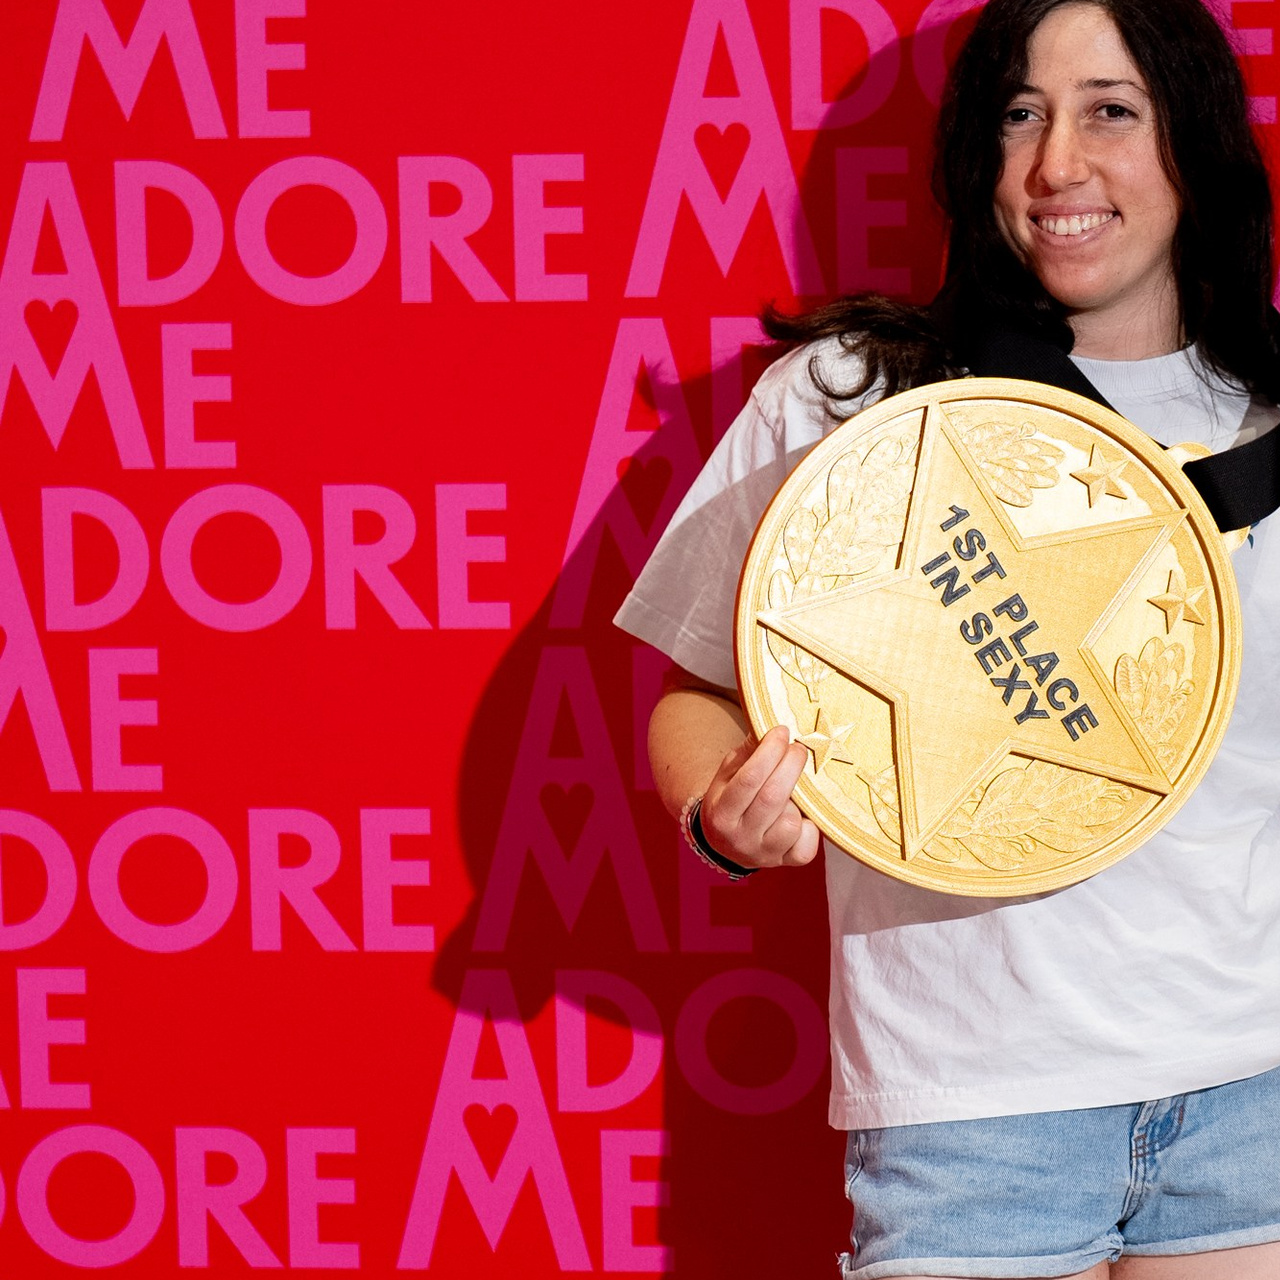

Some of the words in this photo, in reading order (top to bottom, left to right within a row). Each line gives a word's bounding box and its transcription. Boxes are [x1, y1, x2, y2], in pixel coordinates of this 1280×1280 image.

[0, 152, 589, 307] ADORE
[5, 482, 512, 632] DORE
[940, 505, 1007, 584] 1ST
[992, 593, 1099, 742] PLACE
[921, 551, 971, 607] IN
[959, 612, 1050, 725] SEXY
[0, 805, 436, 953] DORE
[432, 971, 828, 1113] ADO
[15, 1123, 361, 1269] ORE
[396, 1105, 672, 1272] ME
